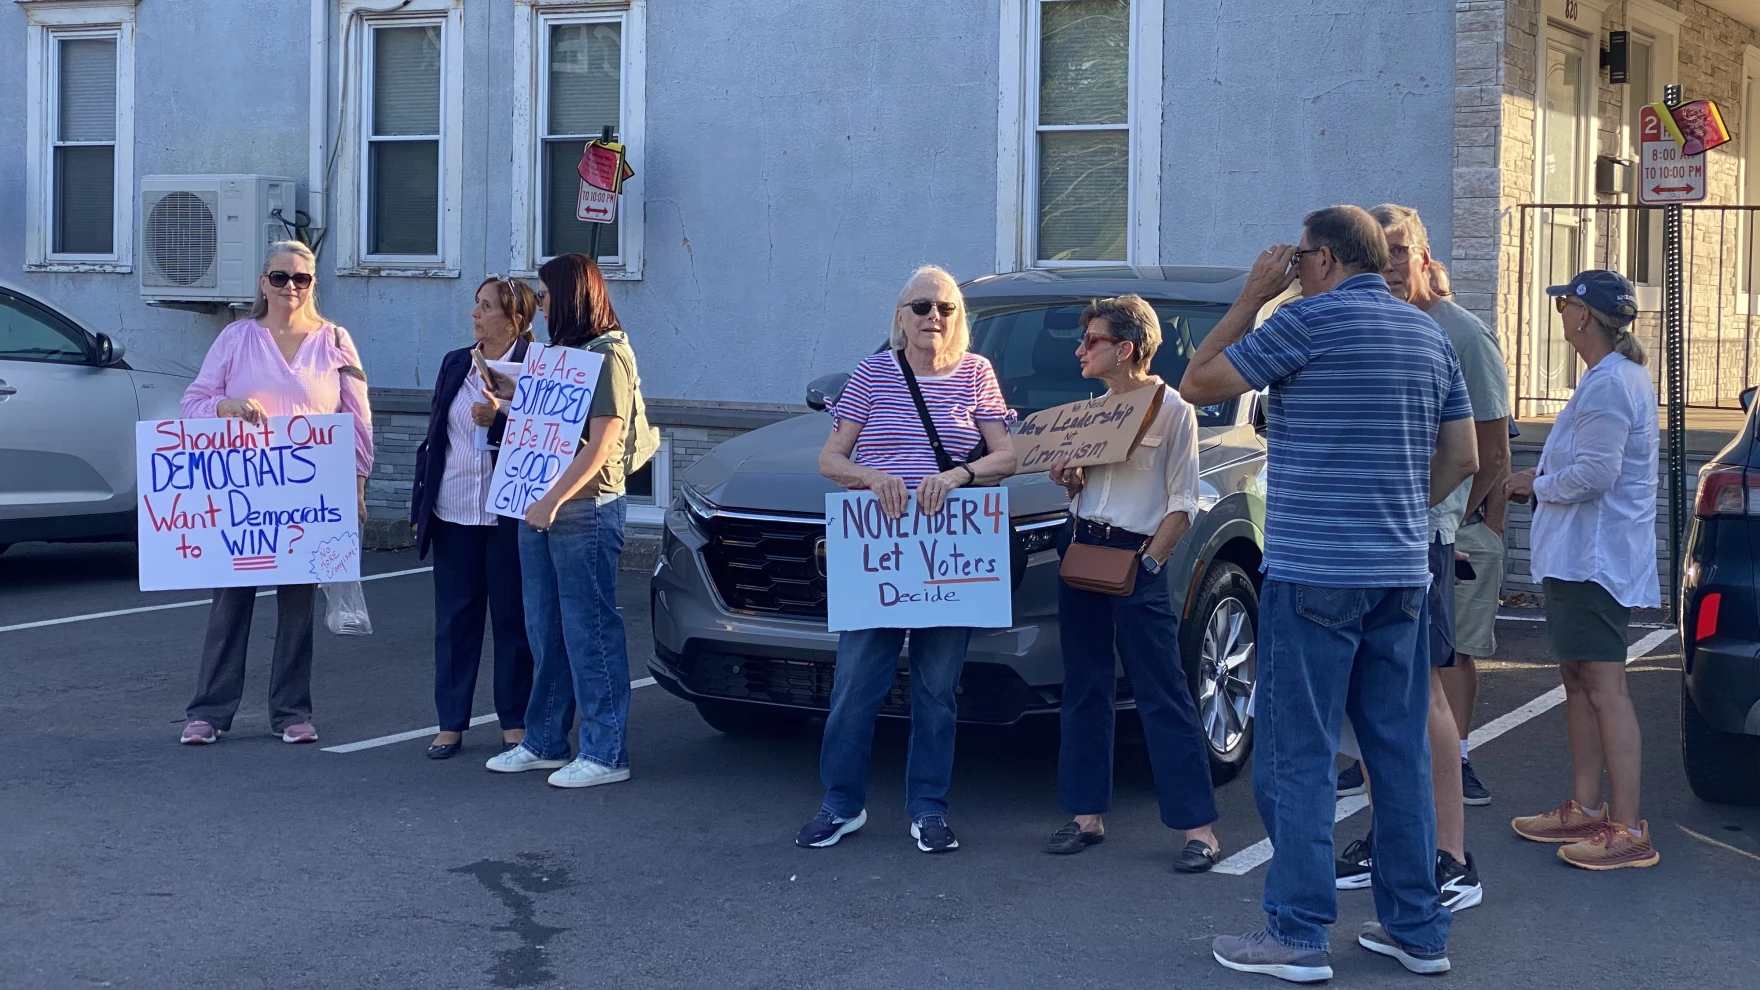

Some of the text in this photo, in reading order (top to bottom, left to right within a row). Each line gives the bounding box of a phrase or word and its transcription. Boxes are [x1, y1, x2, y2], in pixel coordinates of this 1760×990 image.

[1566, 0, 1577, 21] 820
[1645, 116, 1658, 134] 2
[1652, 148, 1676, 161] 8:00
[1645, 165, 1702, 179] TO 10:00 PM
[582, 190, 615, 204] TO 10:00 PM
[527, 349, 586, 384] We Are
[511, 375, 592, 425] SUPPOSED
[1085, 397, 1109, 410] Need
[155, 415, 341, 452] Shouldn't Our
[1017, 403, 1134, 436] New Leadership
[504, 418, 574, 455] To Be The
[151, 446, 316, 492] DEMOCRATS
[504, 447, 561, 484] GOOD
[143, 490, 342, 532] Want Democrats
[842, 493, 1004, 540] NOVEMBER 4
[176, 534, 202, 559] to
[320, 547, 330, 560] NO
[863, 538, 997, 580] Let Voters
[878, 582, 960, 607] Decide
